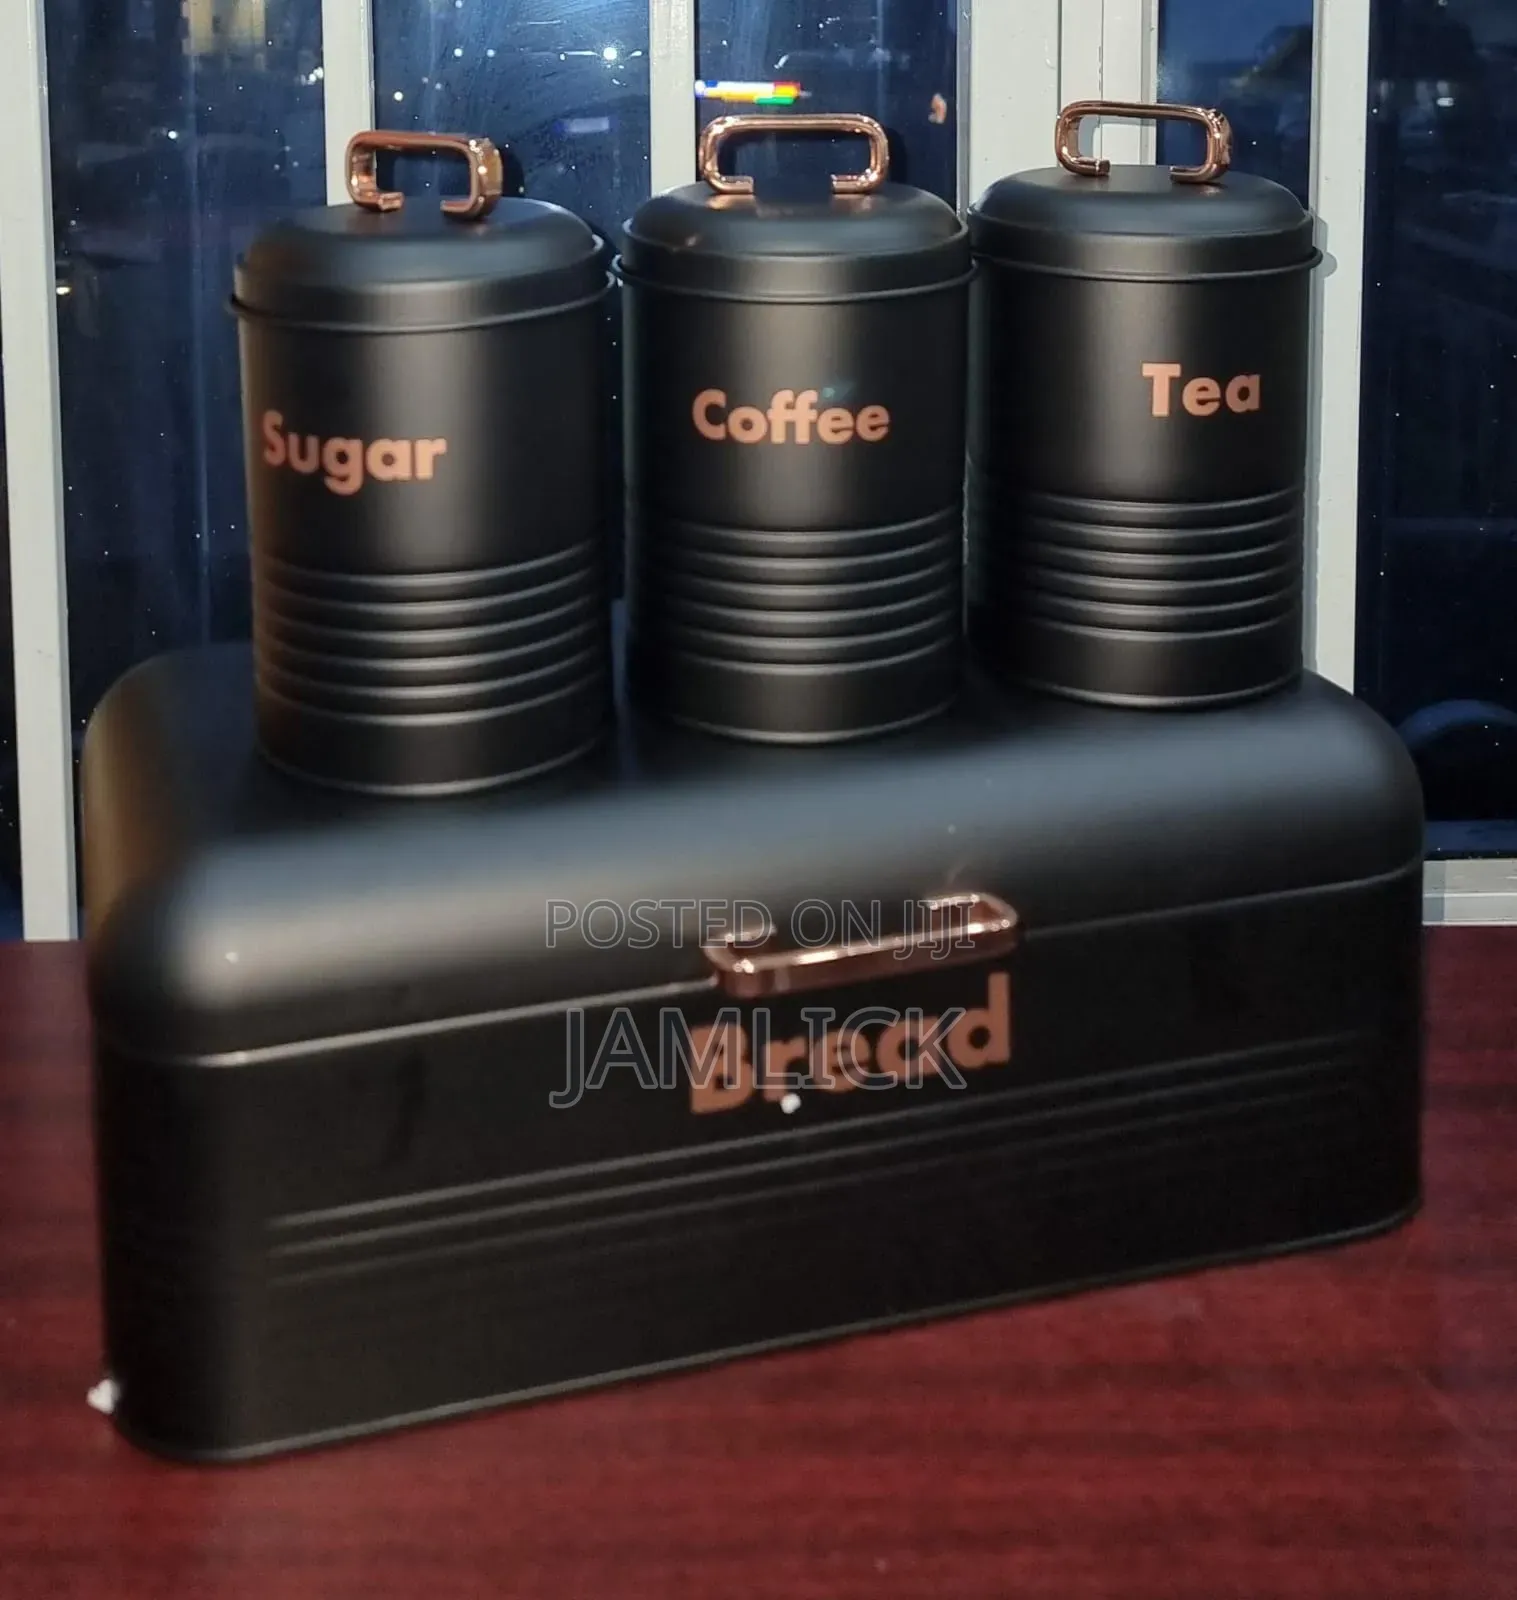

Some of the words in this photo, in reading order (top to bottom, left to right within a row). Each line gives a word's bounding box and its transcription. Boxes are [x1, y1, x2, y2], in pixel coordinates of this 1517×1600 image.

[692, 388, 889, 444] Coffee
[1142, 363, 1261, 417] Tea
[263, 409, 448, 496] Sugar
[691, 971, 1010, 1114] Bread
